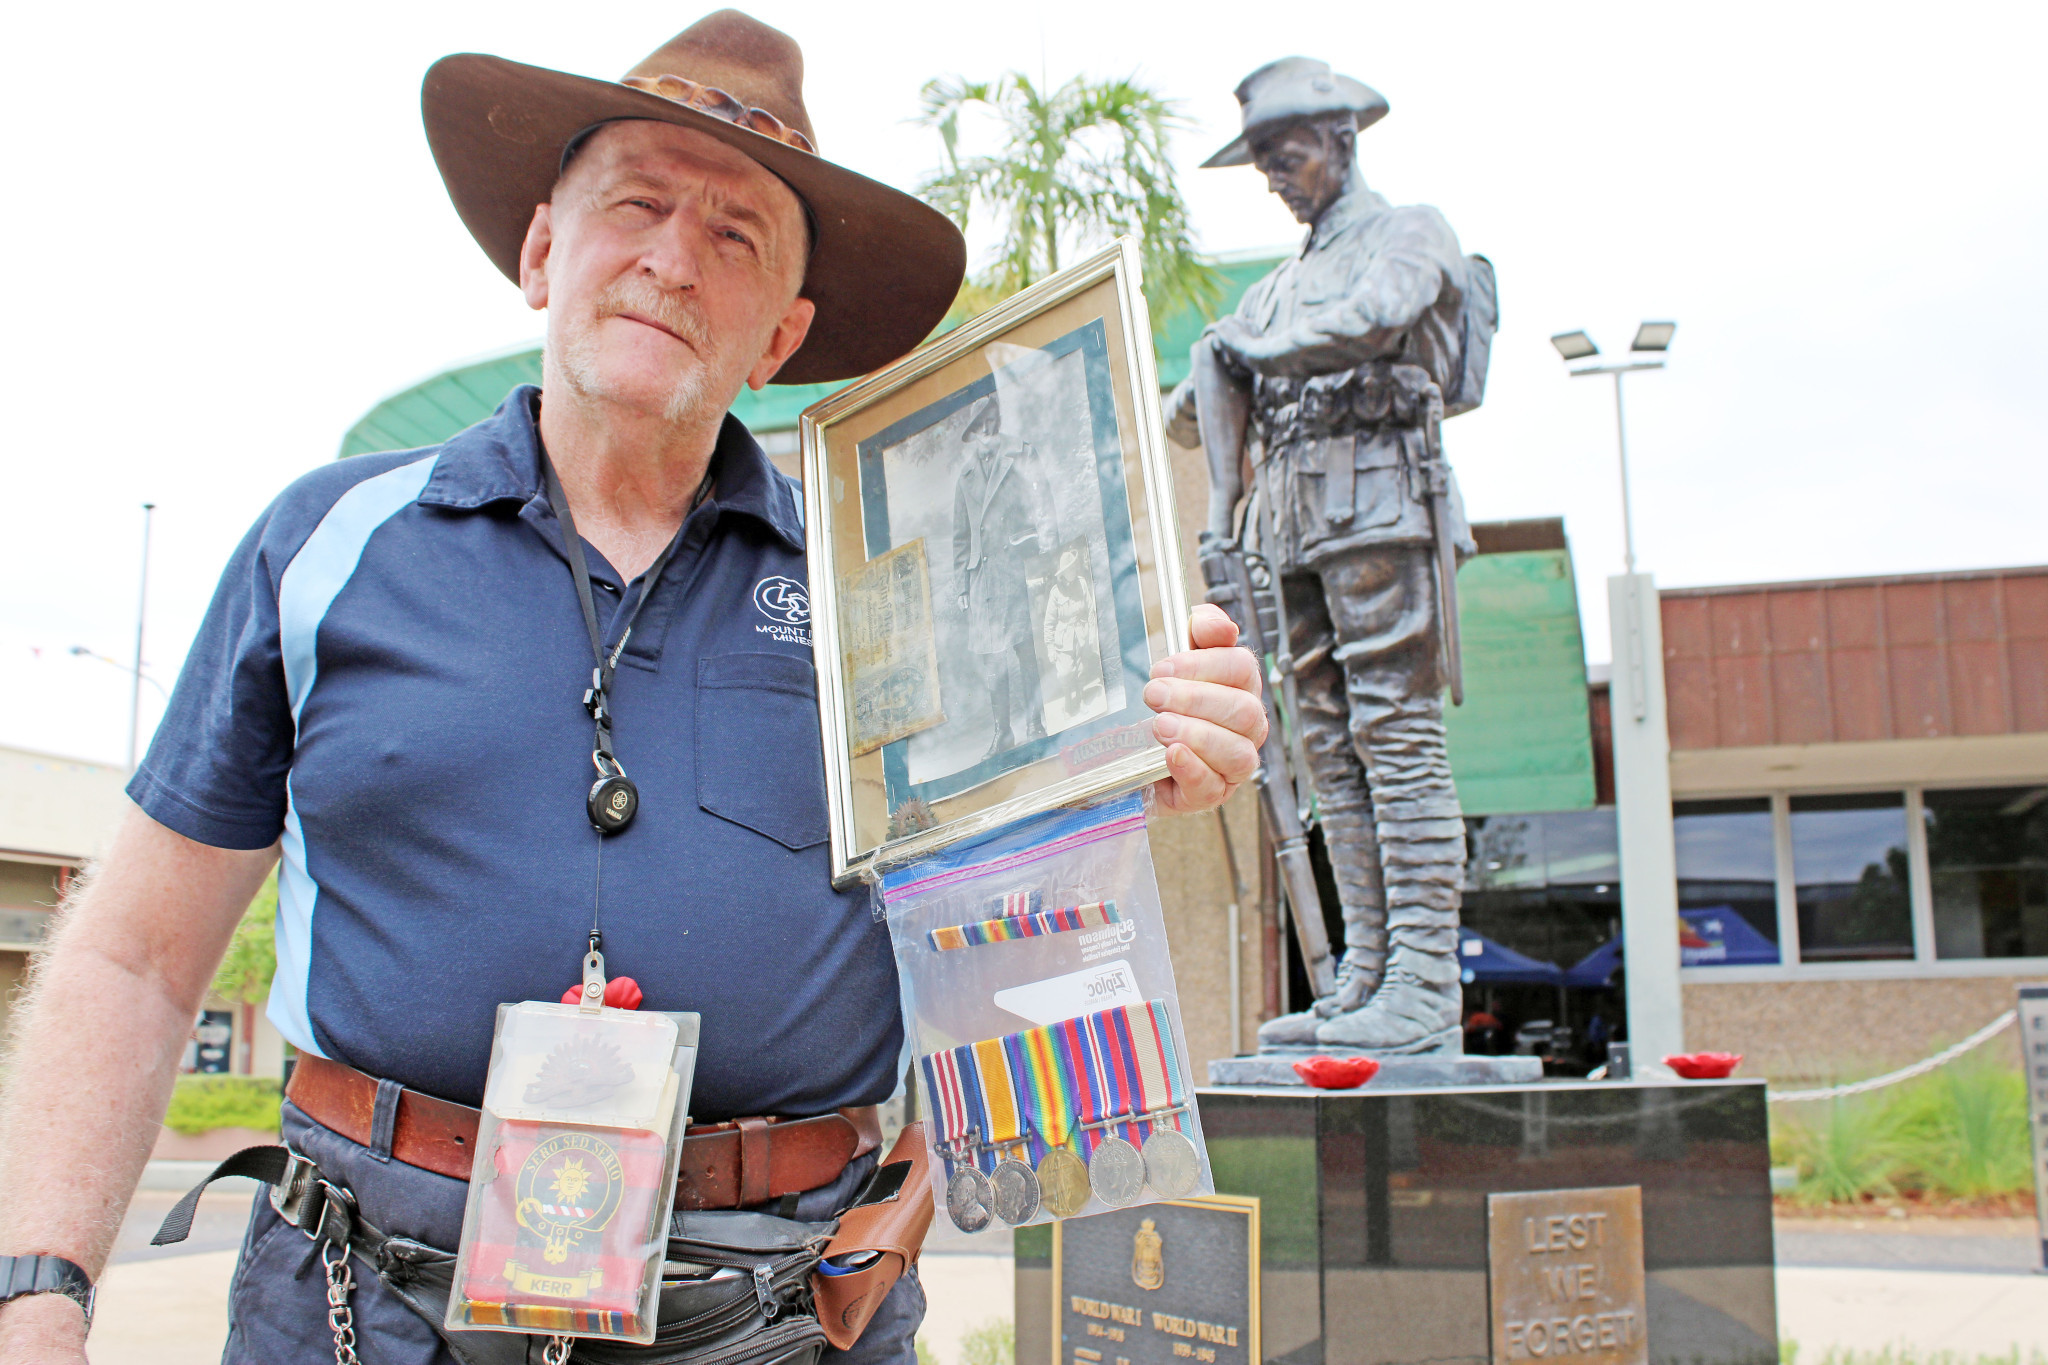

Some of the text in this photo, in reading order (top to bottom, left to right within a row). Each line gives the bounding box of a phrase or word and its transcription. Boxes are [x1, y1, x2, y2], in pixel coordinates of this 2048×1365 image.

[755, 625, 805, 637] MOUNT
[772, 633, 813, 647] MINES
[525, 1135, 621, 1181] SERO SED SERIO
[1525, 1212, 1607, 1254] LEST
[530, 1279, 573, 1295] KERR
[1542, 1263, 1597, 1302] WE
[1071, 1295, 1142, 1327] WORLD WAR I
[1152, 1311, 1238, 1347] WORLD WAR II
[1505, 1309, 1634, 1360] FORGET
